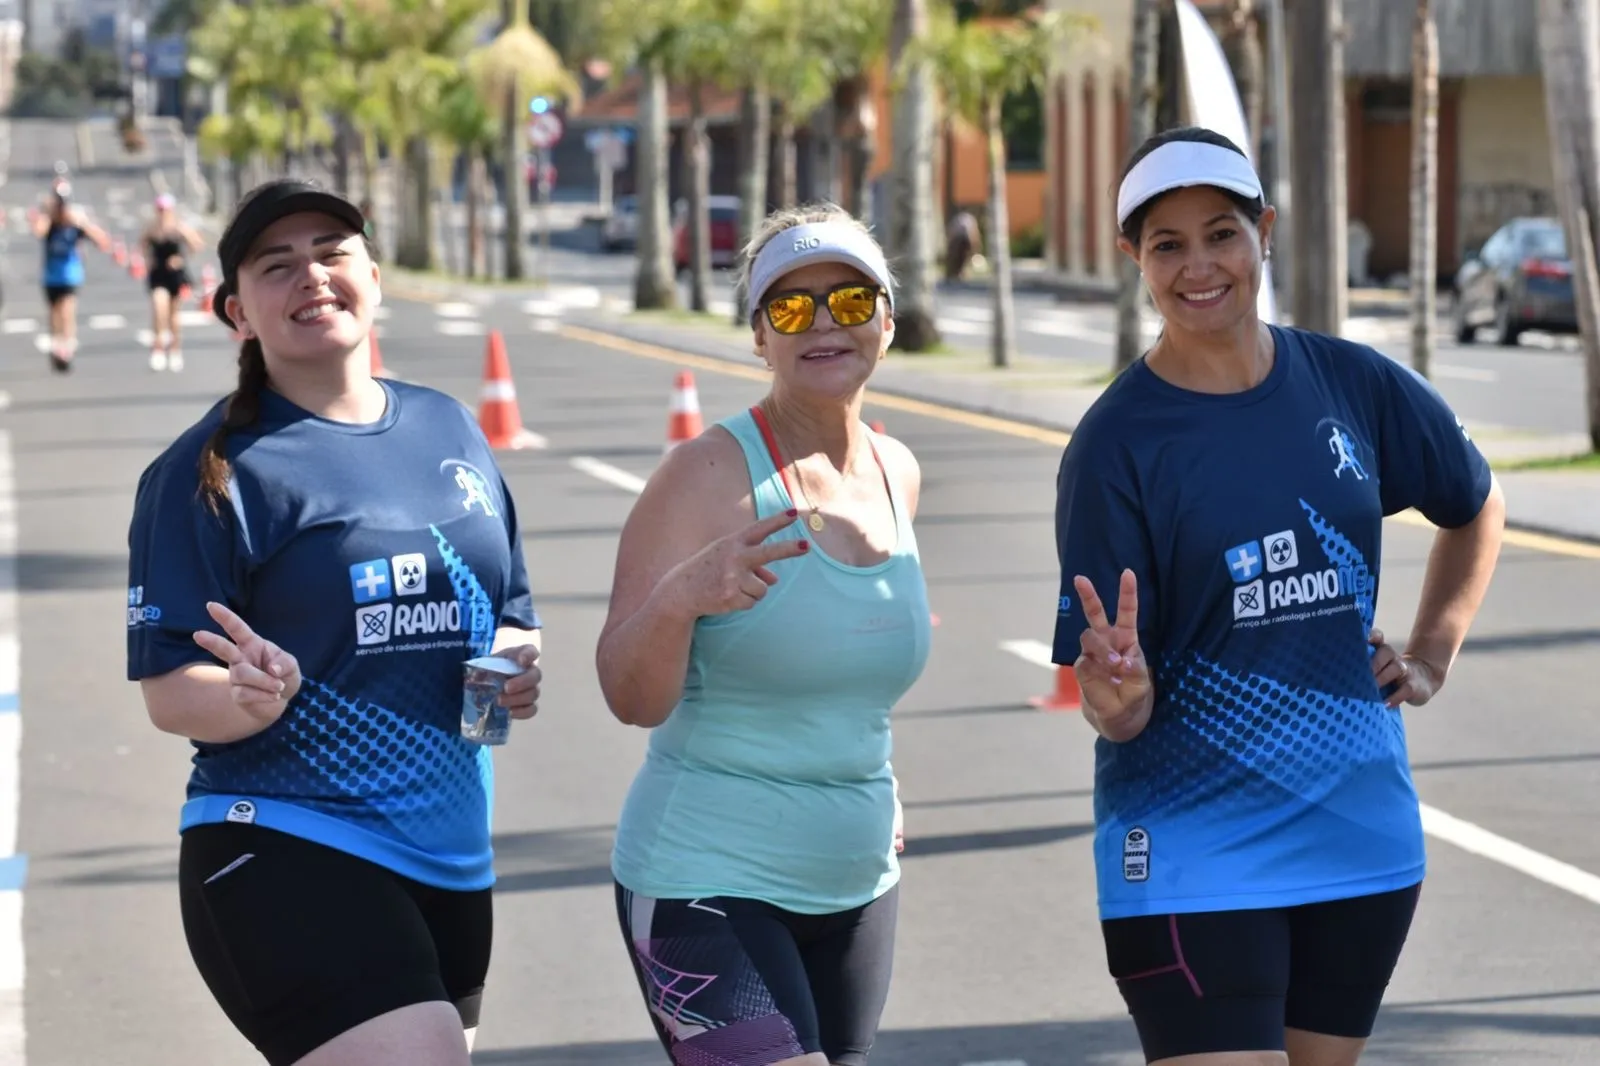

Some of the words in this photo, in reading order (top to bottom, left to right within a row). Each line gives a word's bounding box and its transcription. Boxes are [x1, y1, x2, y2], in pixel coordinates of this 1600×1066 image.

[793, 237, 820, 252] RIO
[1261, 618, 1271, 626] de
[1272, 611, 1311, 623] radiologia
[384, 644, 394, 653] de
